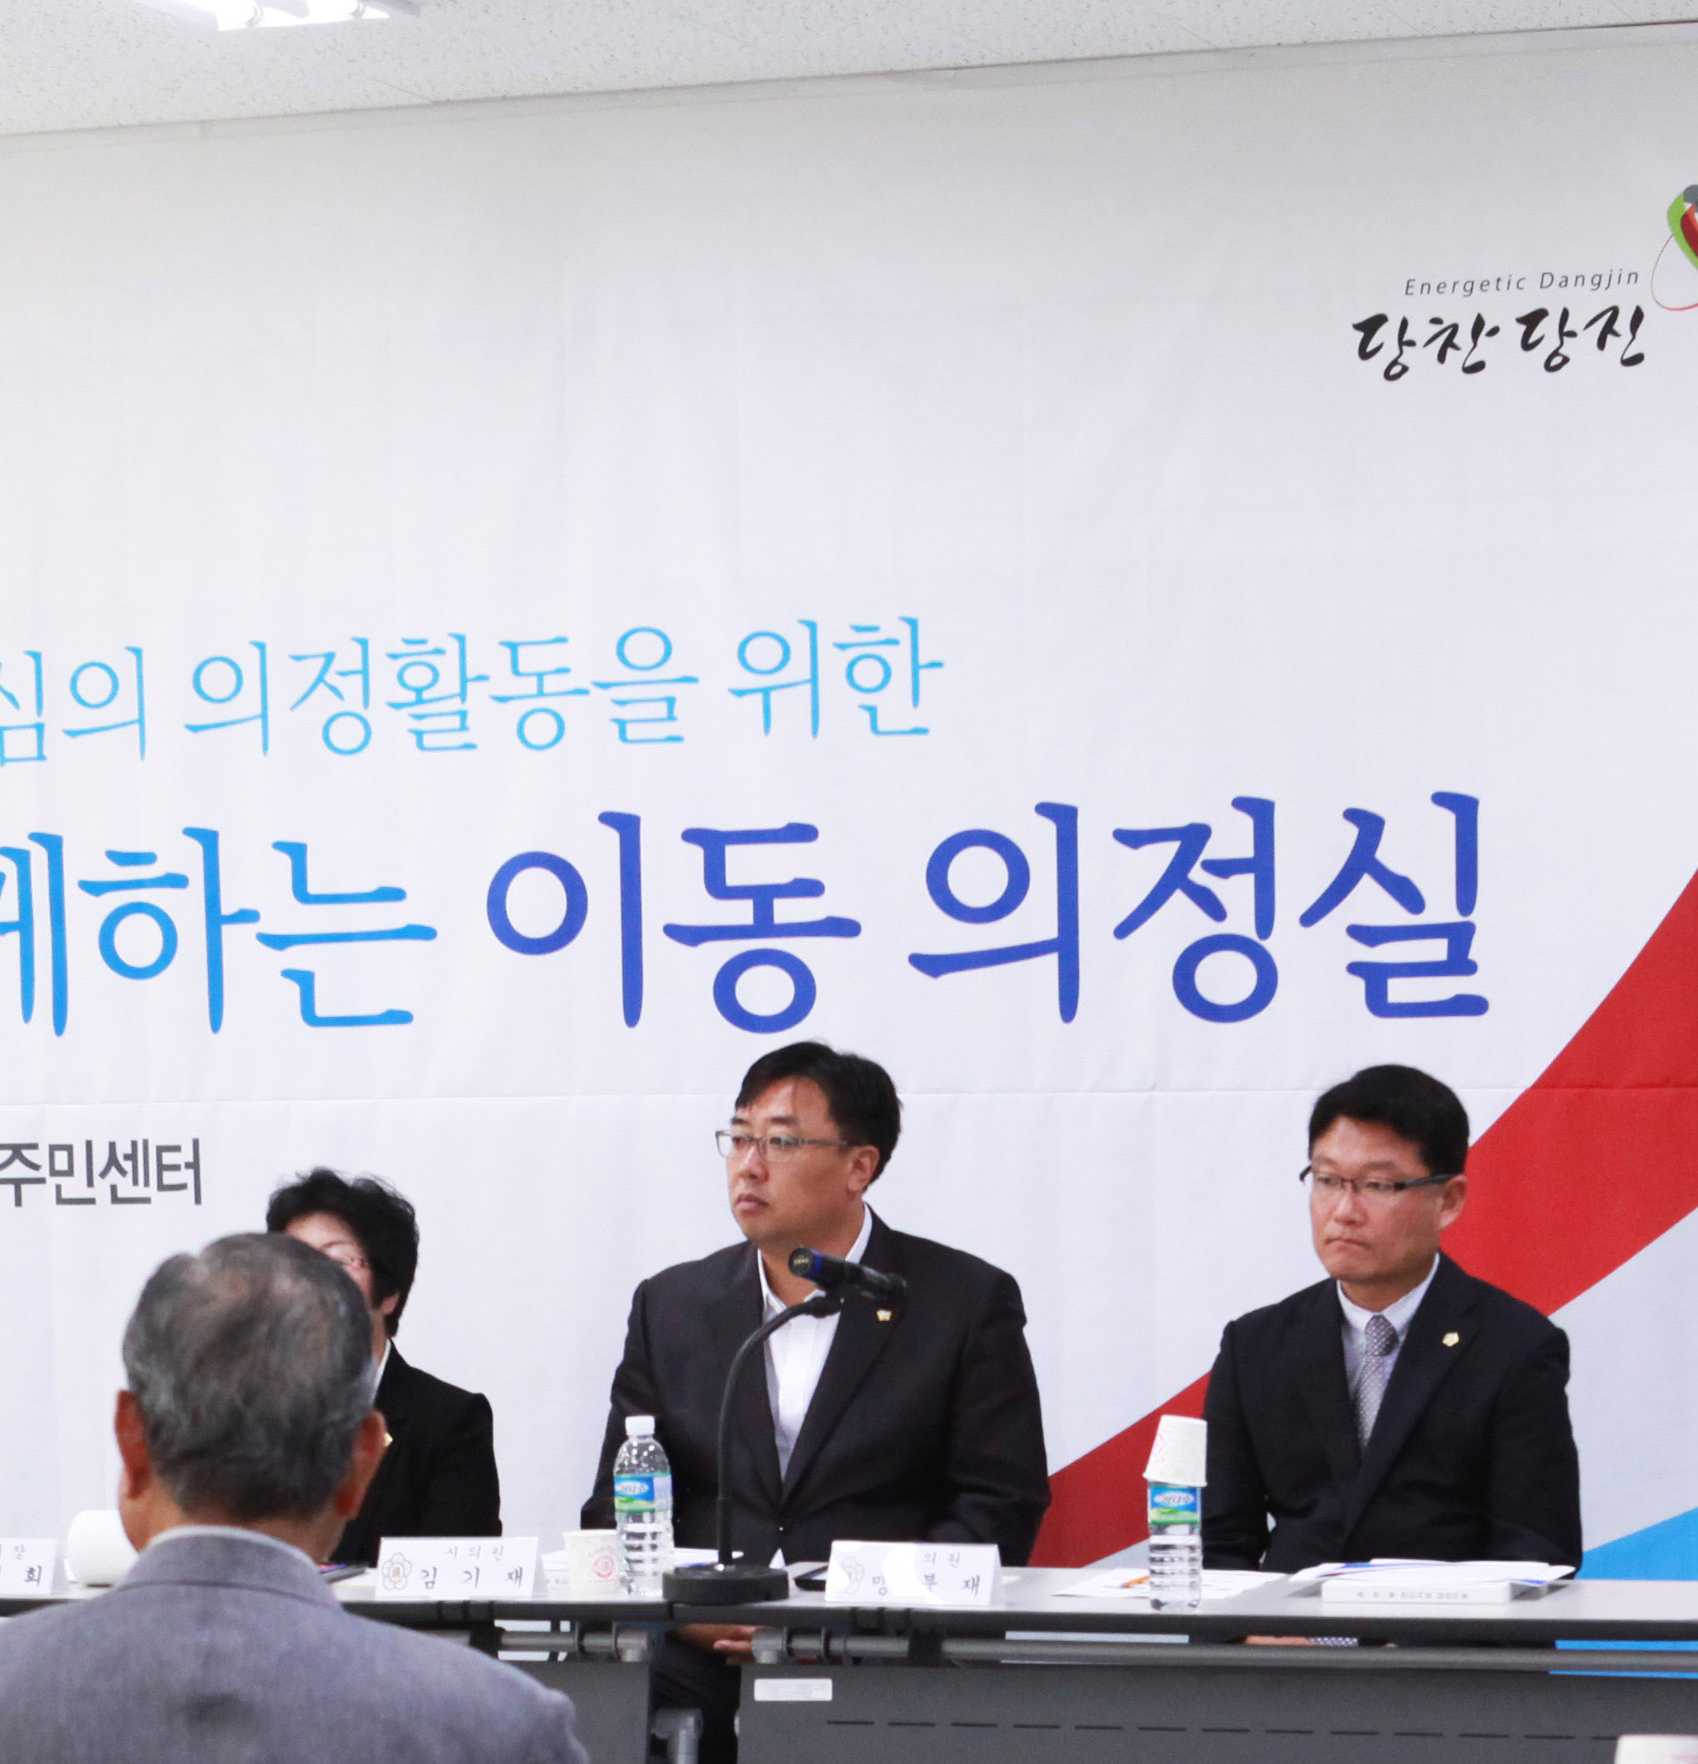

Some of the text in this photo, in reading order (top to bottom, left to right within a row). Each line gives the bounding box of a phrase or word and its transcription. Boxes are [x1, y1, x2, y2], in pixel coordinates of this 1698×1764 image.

[1404, 268, 1640, 298] Energetic Dangjin
[1352, 304, 1645, 382] 당찬 당진
[184, 626, 699, 757] 의정활동을
[728, 616, 944, 738] 위한
[486, 811, 862, 1034] 이동
[908, 791, 1489, 1024] 의정실
